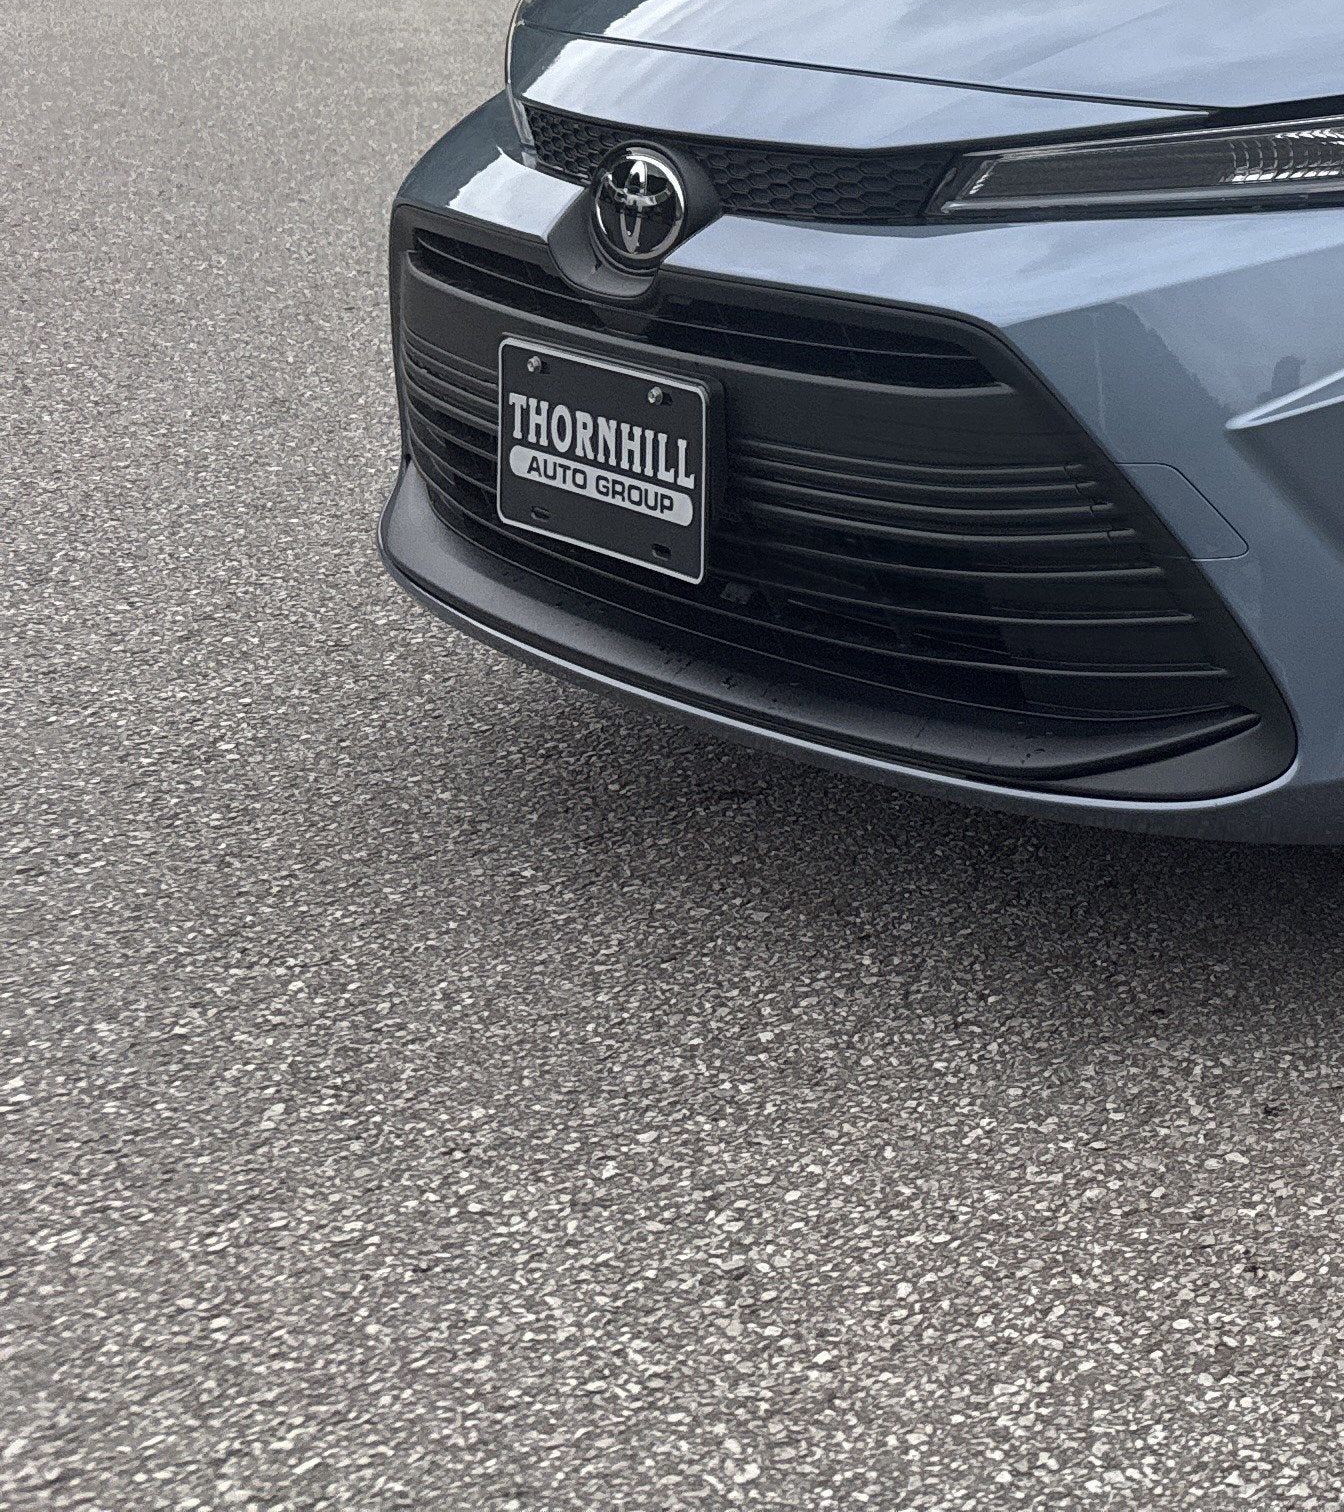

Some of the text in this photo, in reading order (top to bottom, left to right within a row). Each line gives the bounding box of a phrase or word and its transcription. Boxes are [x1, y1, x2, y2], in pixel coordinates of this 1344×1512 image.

[509, 393, 695, 489] THORNHILL
[527, 456, 674, 514] AUTO GROUP
